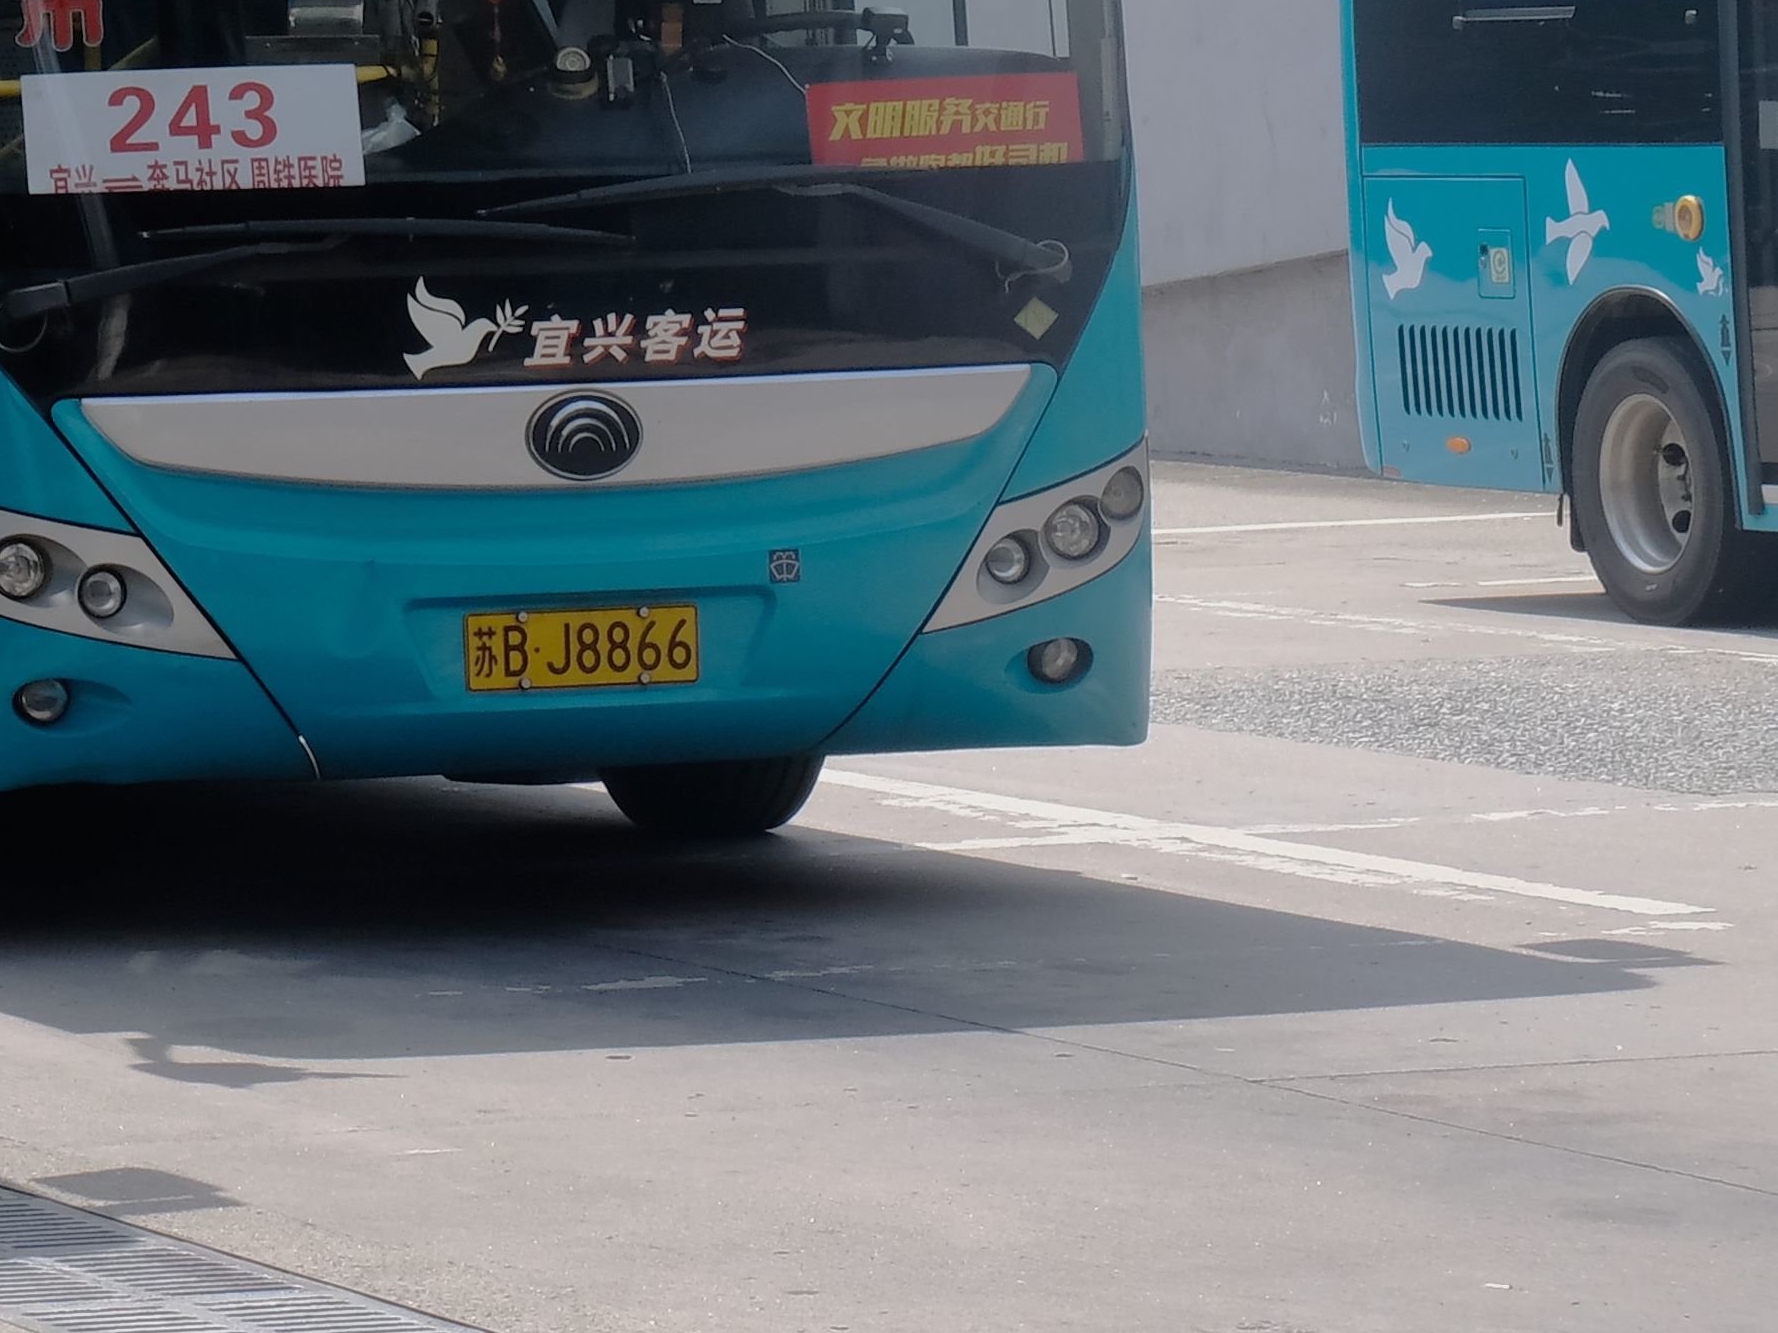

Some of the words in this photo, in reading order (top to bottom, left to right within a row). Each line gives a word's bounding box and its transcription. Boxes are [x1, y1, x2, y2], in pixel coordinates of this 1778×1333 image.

[107, 81, 278, 153] 243
[829, 97, 1050, 141] 文明服务交通行
[49, 164, 95, 194] 宜兴
[251, 154, 344, 189] 周铁医院
[523, 307, 748, 371] 宜兴客运
[473, 618, 692, 678] 苏B·J8866
